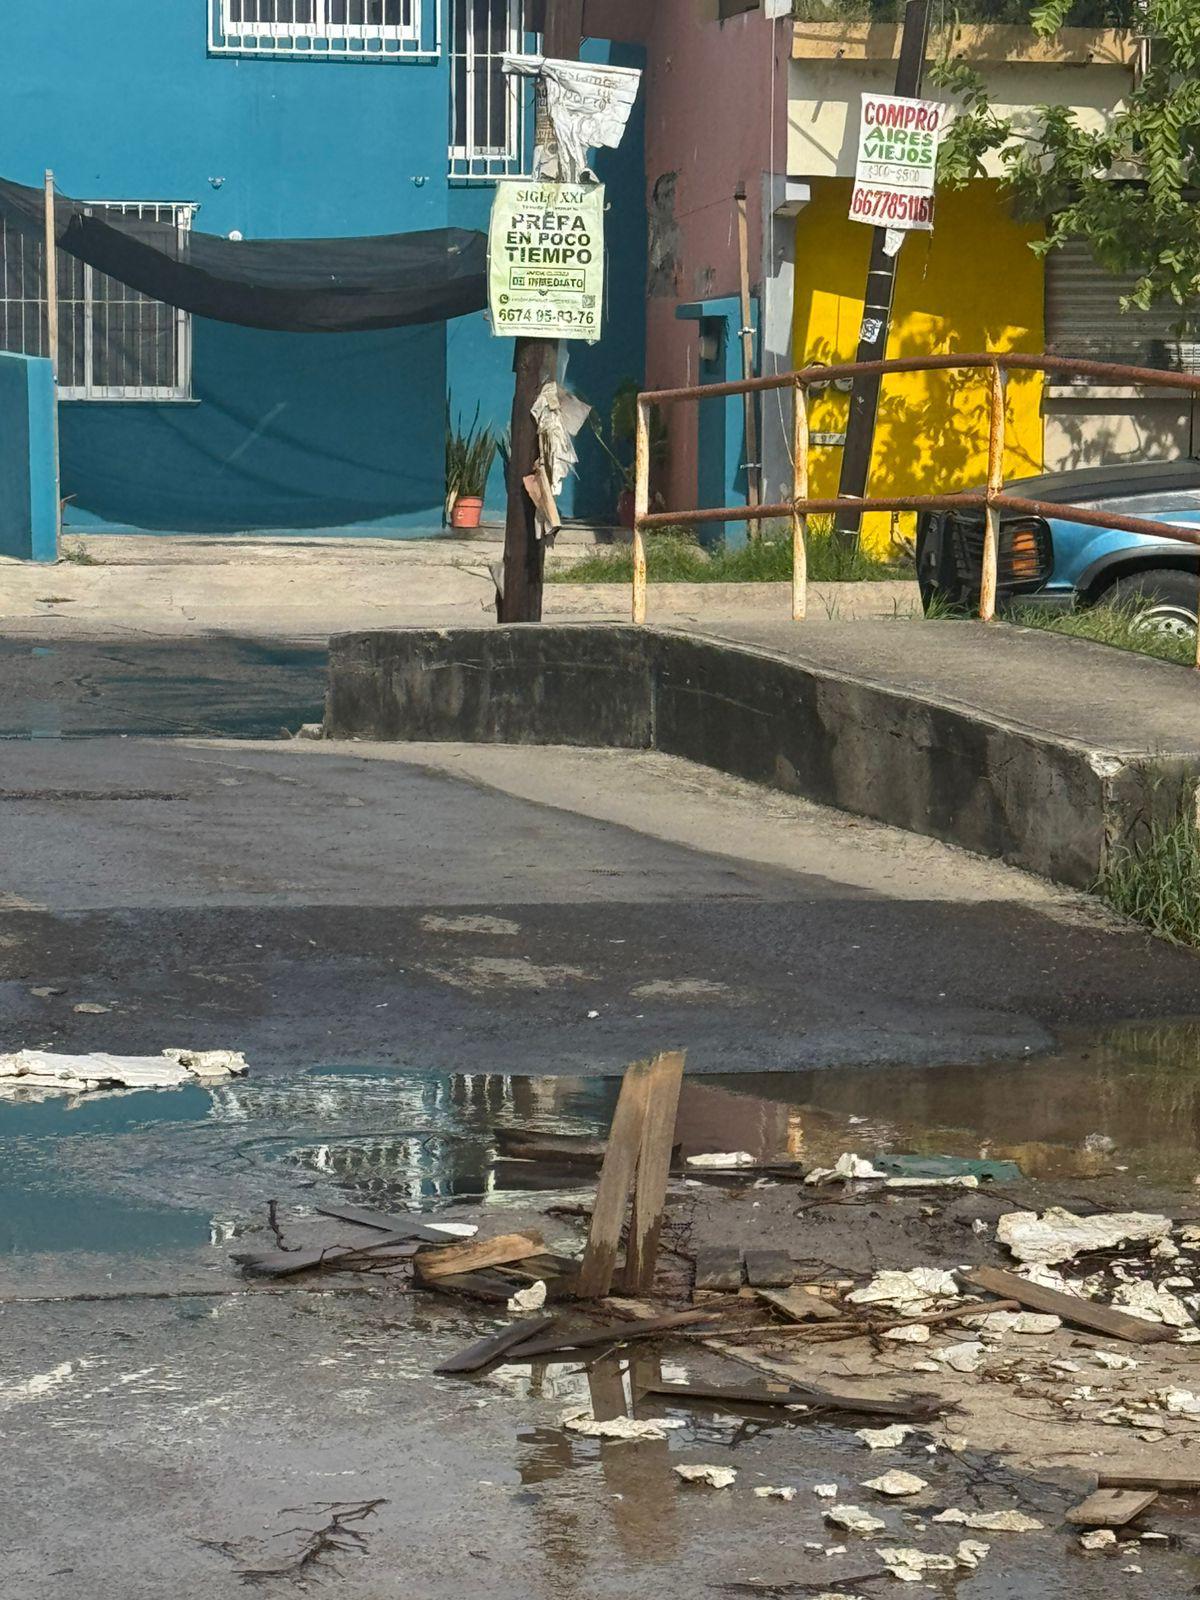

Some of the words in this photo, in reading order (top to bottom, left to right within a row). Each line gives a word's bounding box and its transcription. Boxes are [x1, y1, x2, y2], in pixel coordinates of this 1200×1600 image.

[864, 101, 939, 132] COMPRO
[865, 127, 933, 147] AIRES
[863, 143, 932, 163] VIEJOS
[560, 191, 584, 204] XXI
[511, 213, 586, 232] PREPA
[506, 231, 532, 245] EN
[538, 232, 591, 247] POCO
[504, 246, 592, 265] TIEMPO
[512, 276, 526, 287] DE
[528, 277, 584, 289] INMEDIATO
